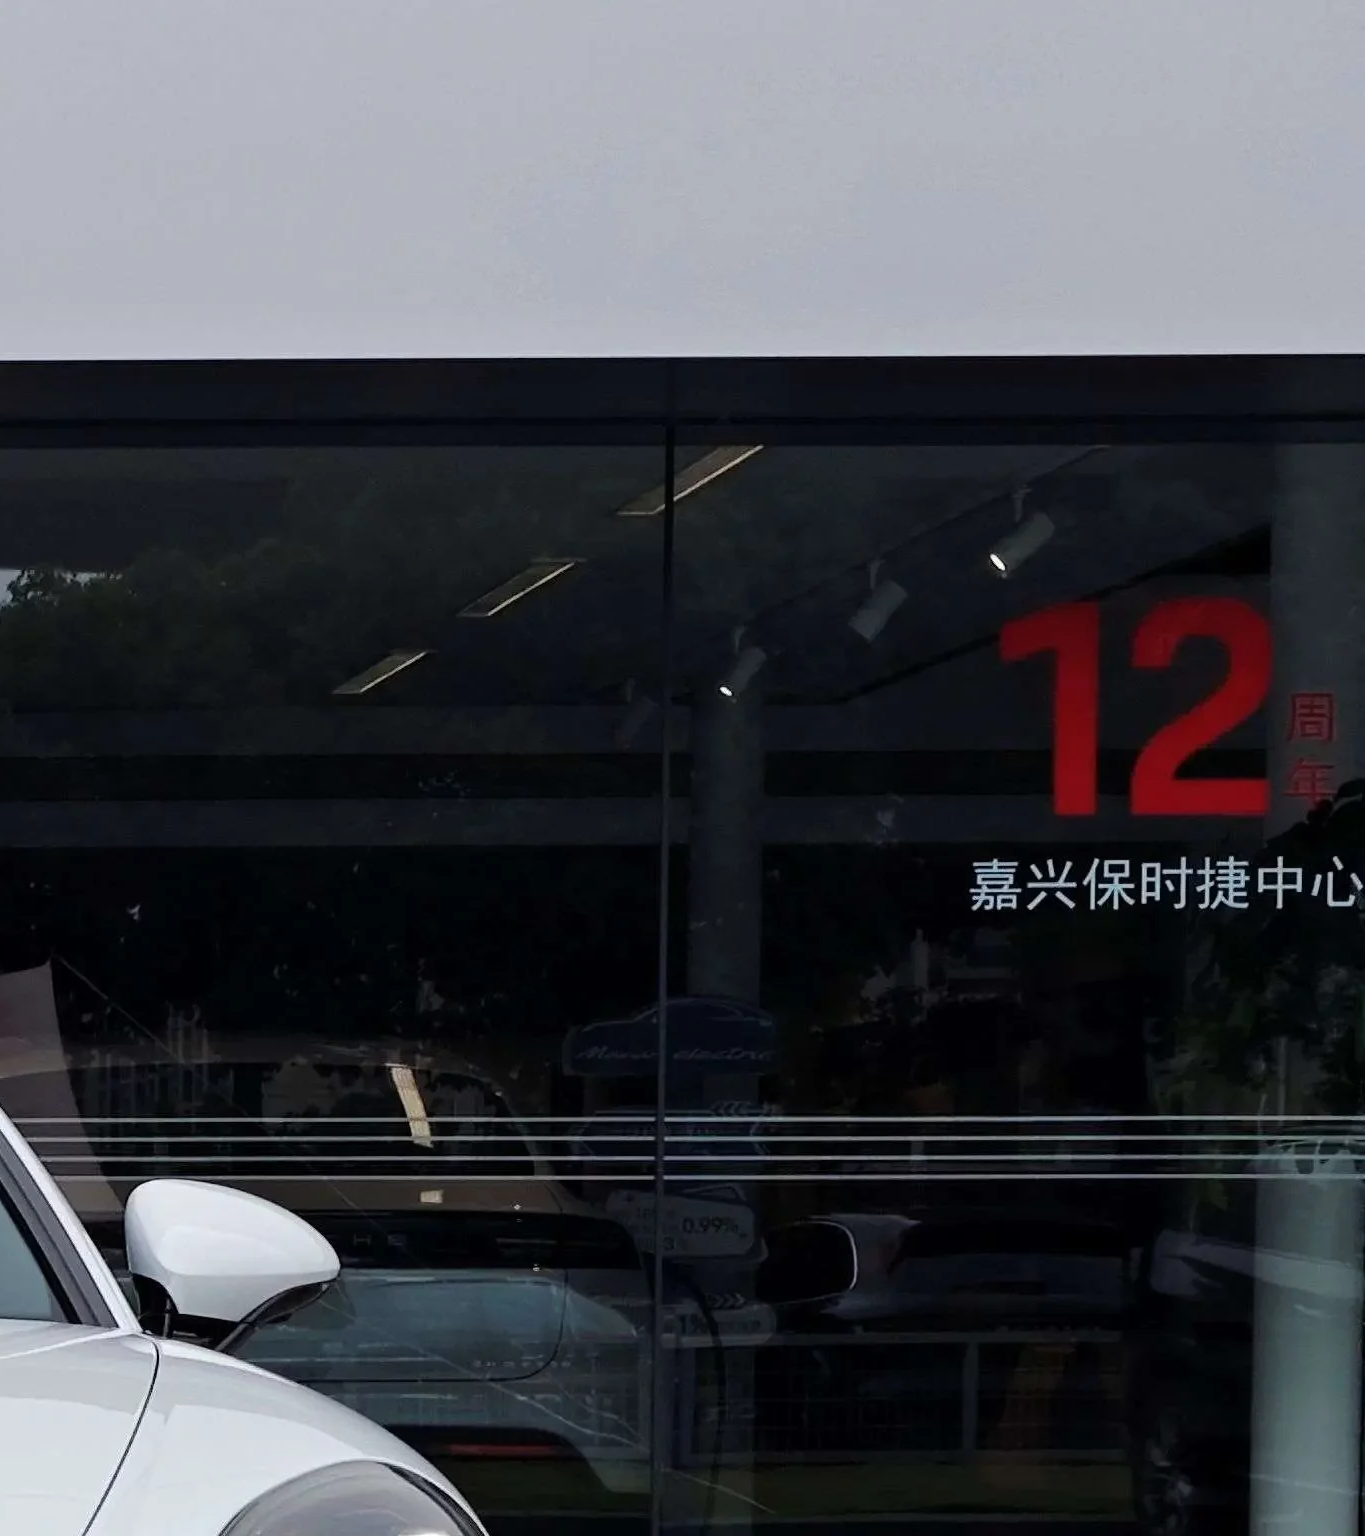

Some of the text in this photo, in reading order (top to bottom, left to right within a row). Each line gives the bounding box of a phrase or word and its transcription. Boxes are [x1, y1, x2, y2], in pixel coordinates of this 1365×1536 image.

[998, 596, 1272, 816] 12
[1281, 692, 1336, 814] 周年
[969, 856, 1364, 911] 嘉兴保时捷中心
